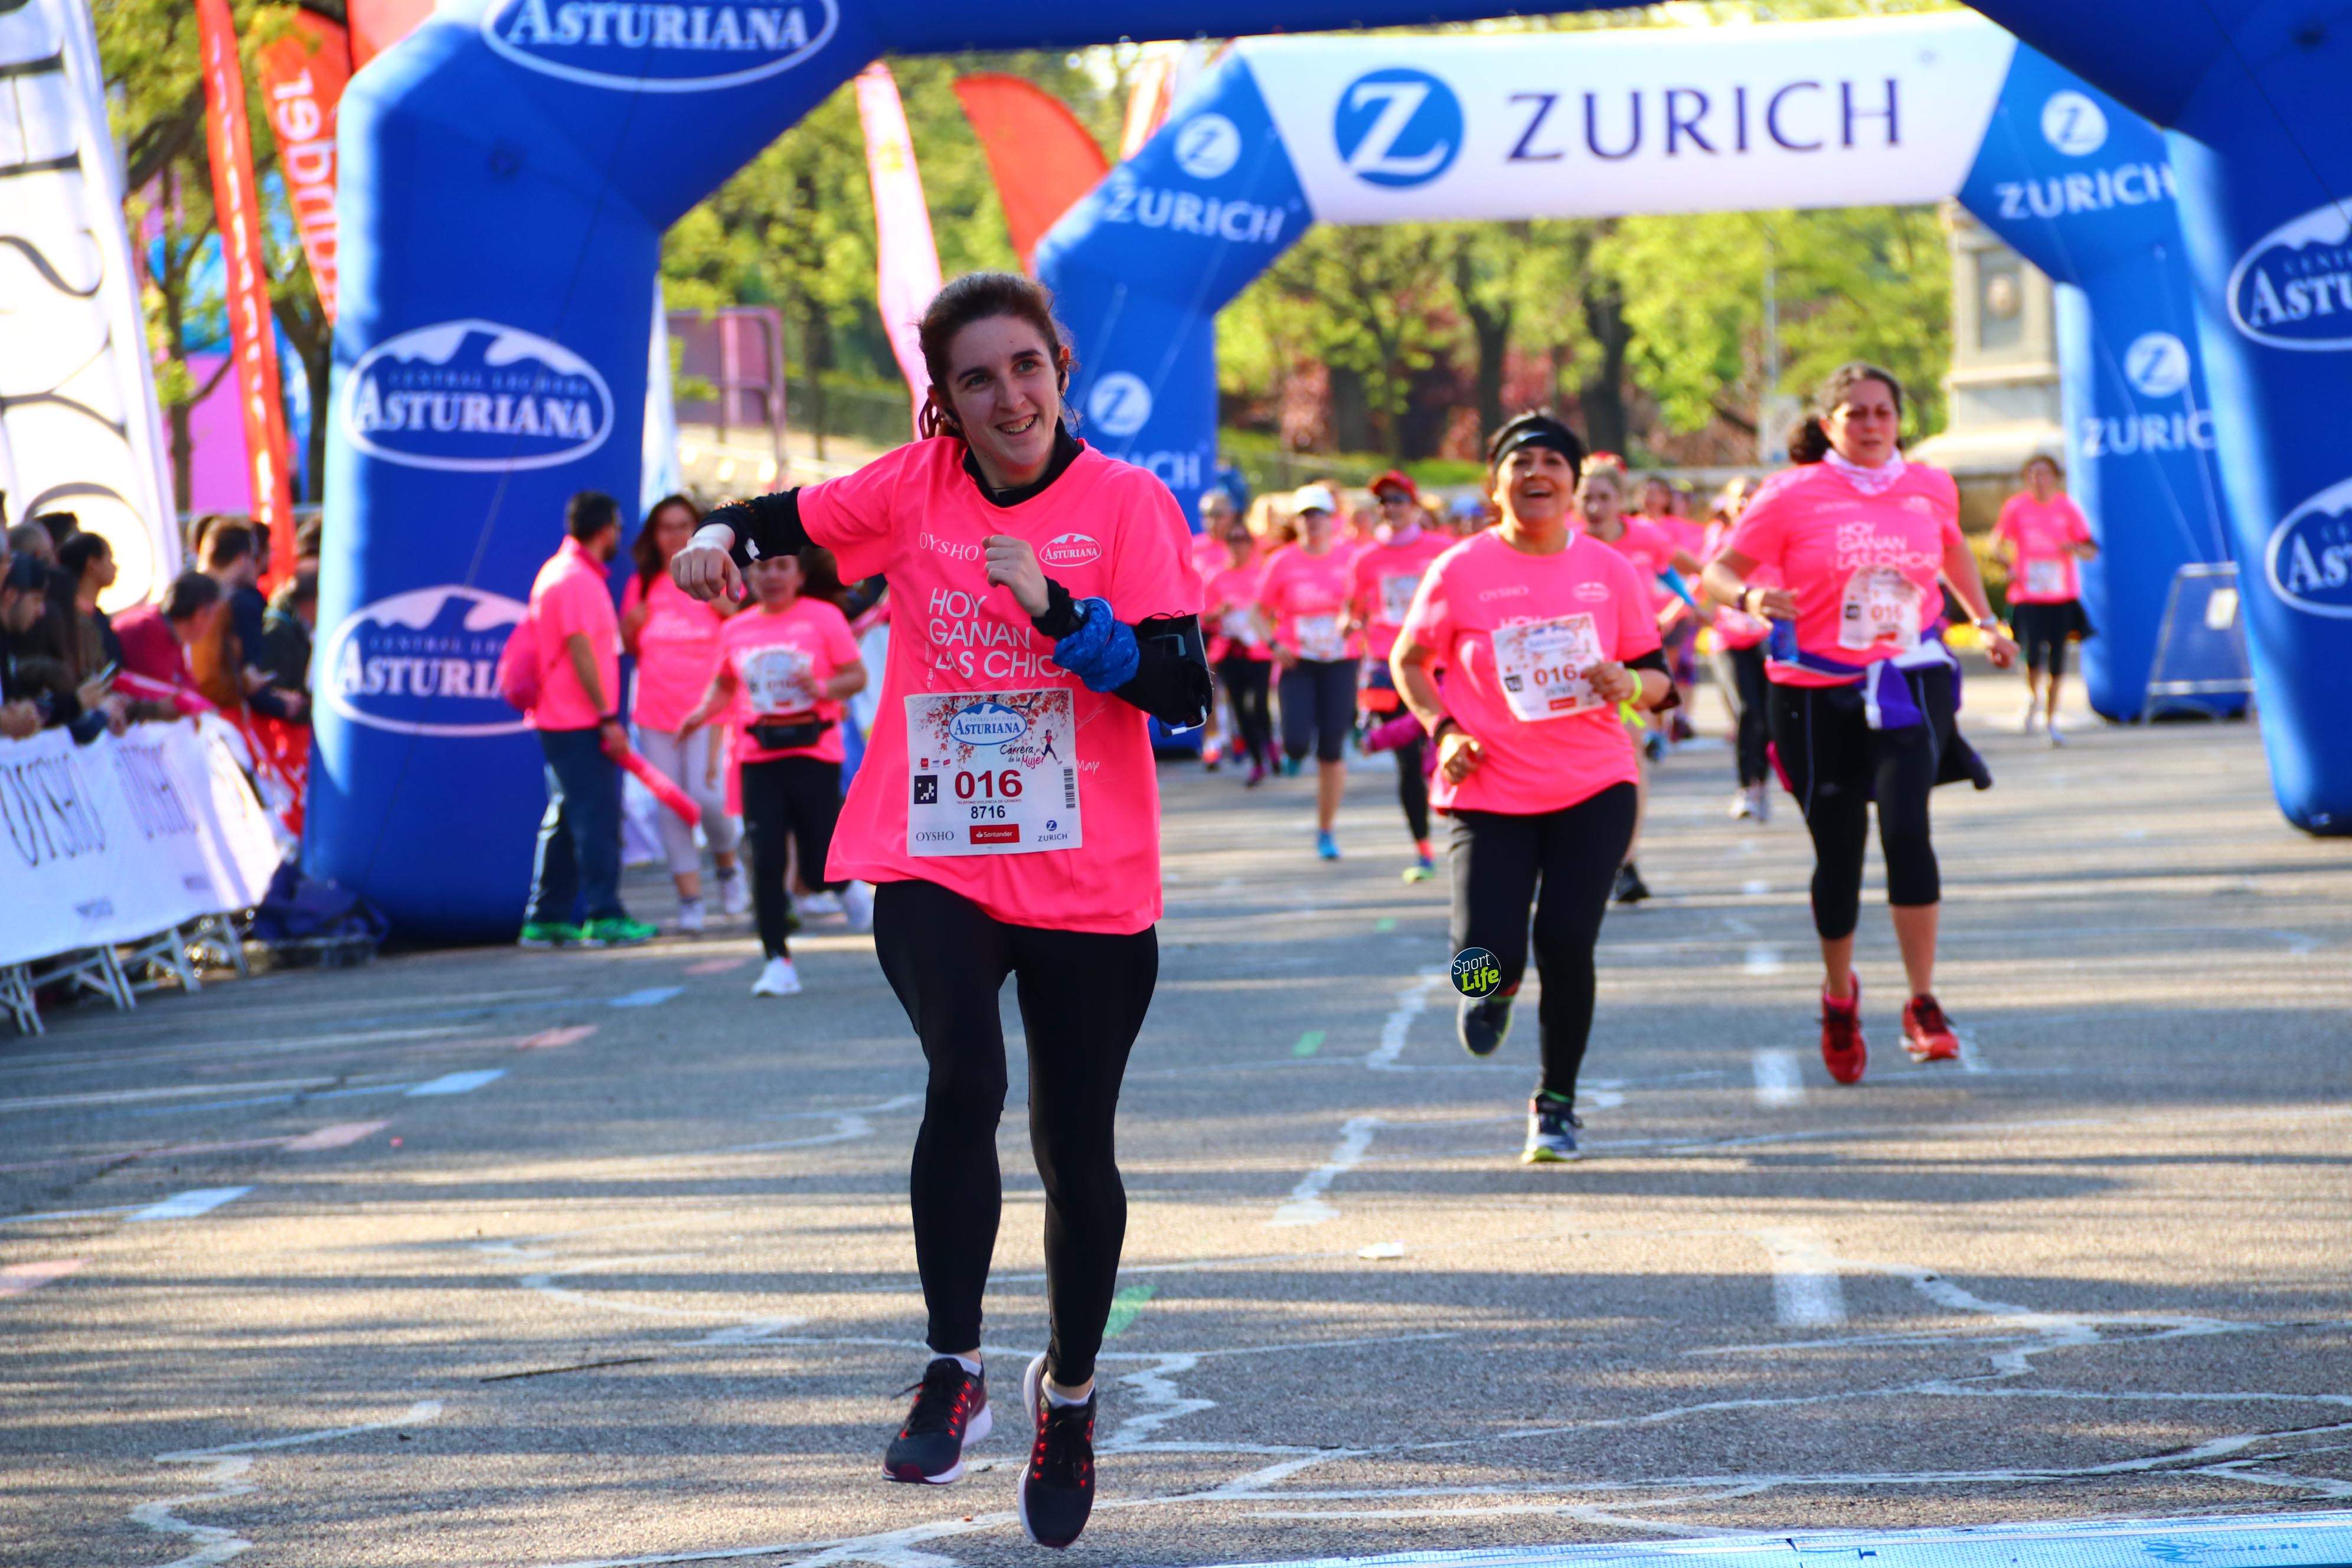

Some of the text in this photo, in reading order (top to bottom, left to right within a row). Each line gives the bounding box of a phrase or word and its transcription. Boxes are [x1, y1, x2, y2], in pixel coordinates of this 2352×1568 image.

[509, 0, 808, 50] ASTURIANA
[1507, 78, 1902, 163] ZURICH
[1102, 184, 1286, 244] ZURICH
[355, 373, 595, 440] ASTURIANA
[2078, 409, 2217, 458] ZURIC
[919, 532, 979, 561] OYSHO
[1045, 547, 1097, 560] ASTURIANA
[928, 588, 987, 618] HOY
[929, 618, 1031, 649] GANAN
[935, 651, 1076, 679] LAS CHIC
[1533, 663, 1578, 687] 016
[955, 718, 1021, 736] ASTURIANA
[1000, 744, 1034, 755] Carrera
[1020, 753, 1047, 769] Mujer
[955, 769, 1023, 799] 016
[971, 805, 1005, 819] 8716
[916, 831, 955, 841] OYSHO
[1037, 834, 1067, 842] ZURICH
